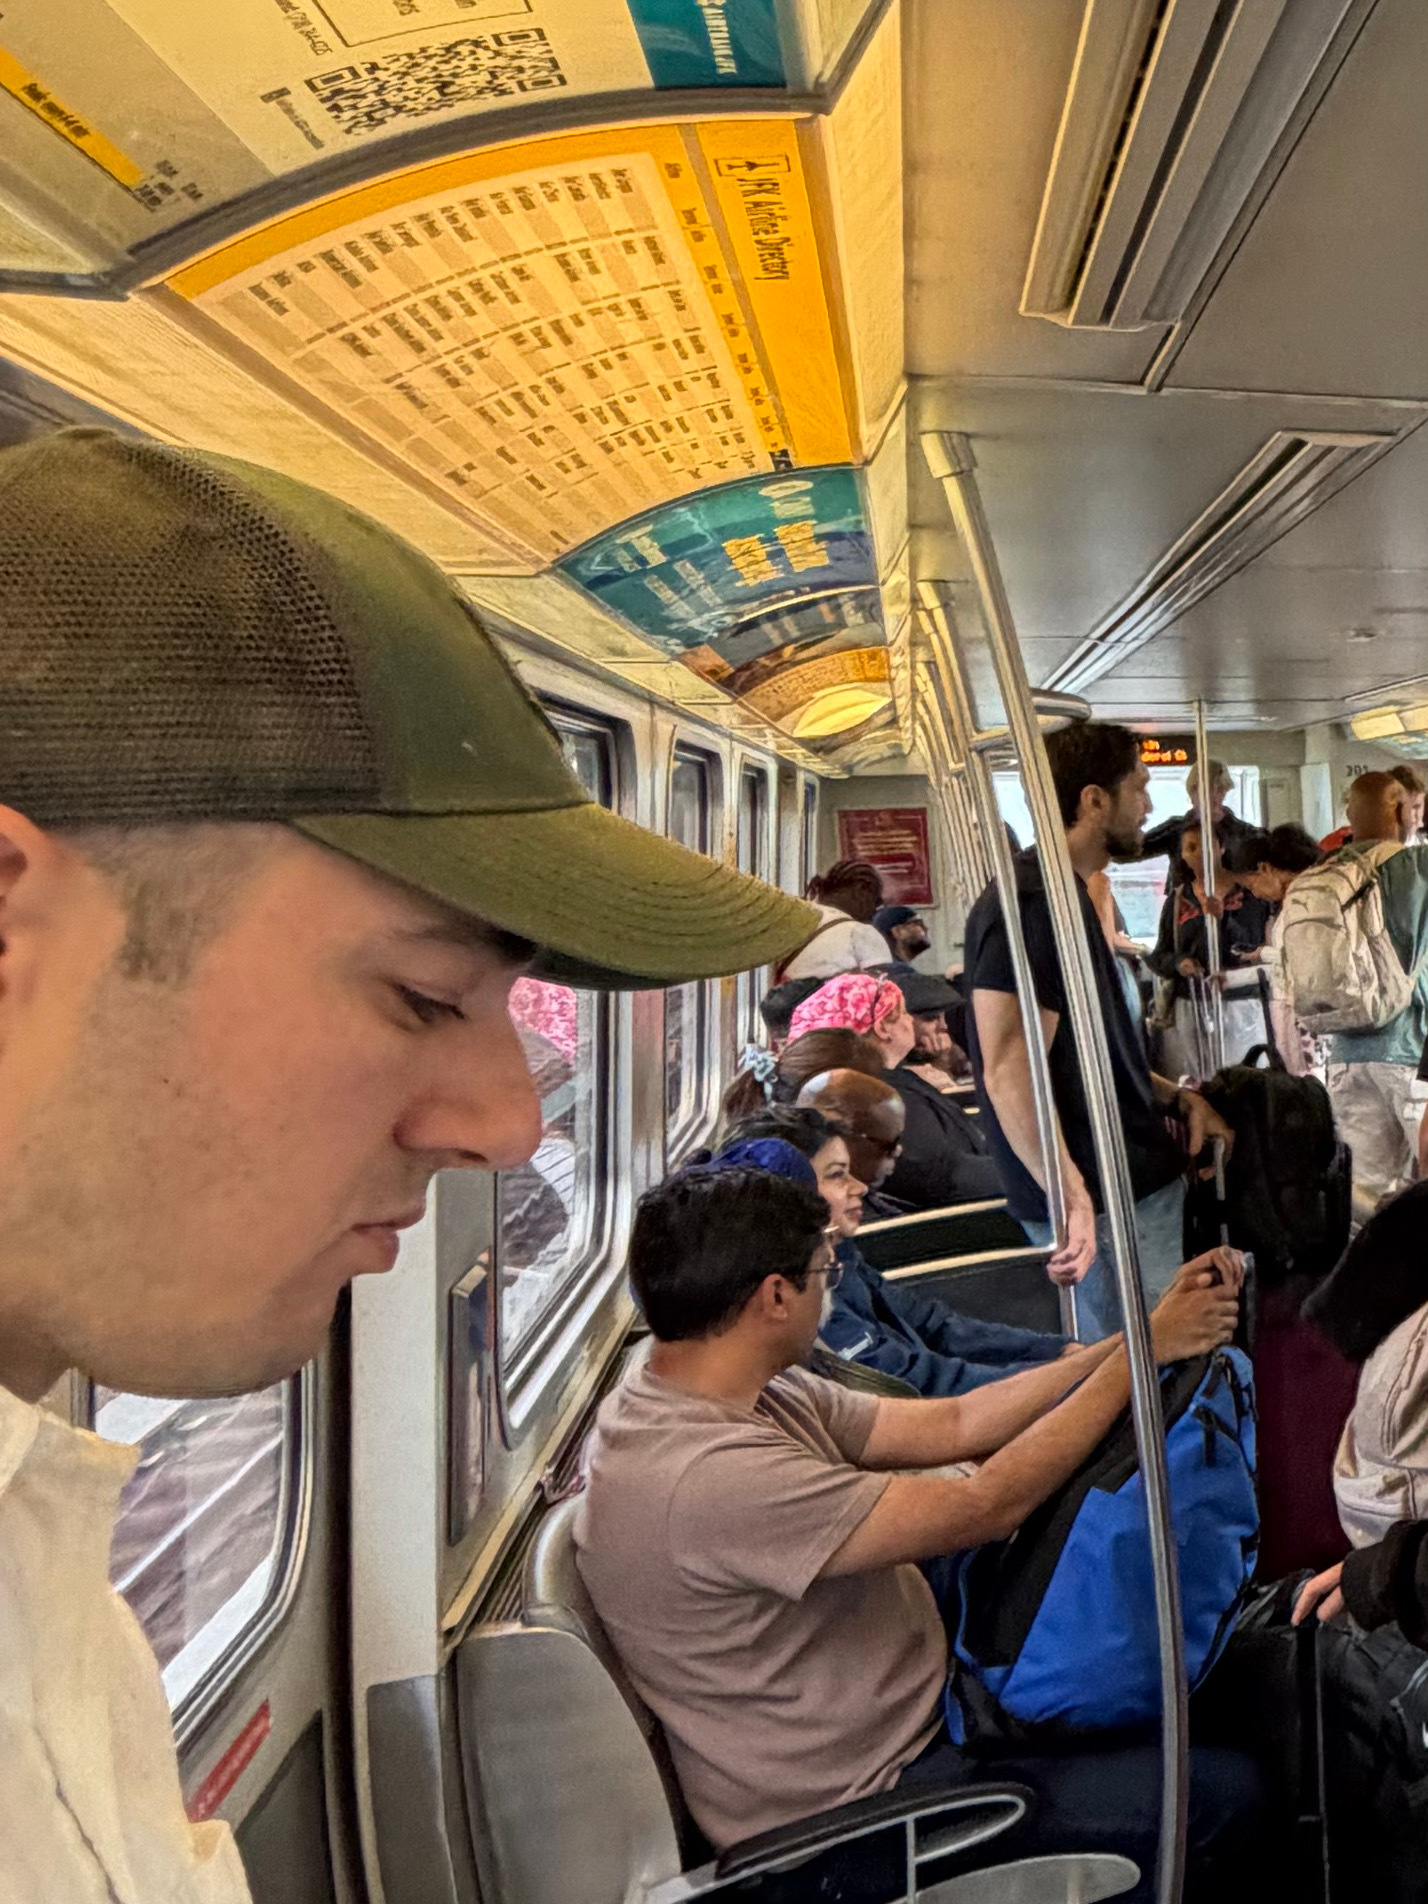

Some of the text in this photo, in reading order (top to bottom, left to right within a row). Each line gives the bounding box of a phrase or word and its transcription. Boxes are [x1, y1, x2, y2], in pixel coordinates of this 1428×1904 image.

[737, 177, 795, 283] JFK Airline Directory
